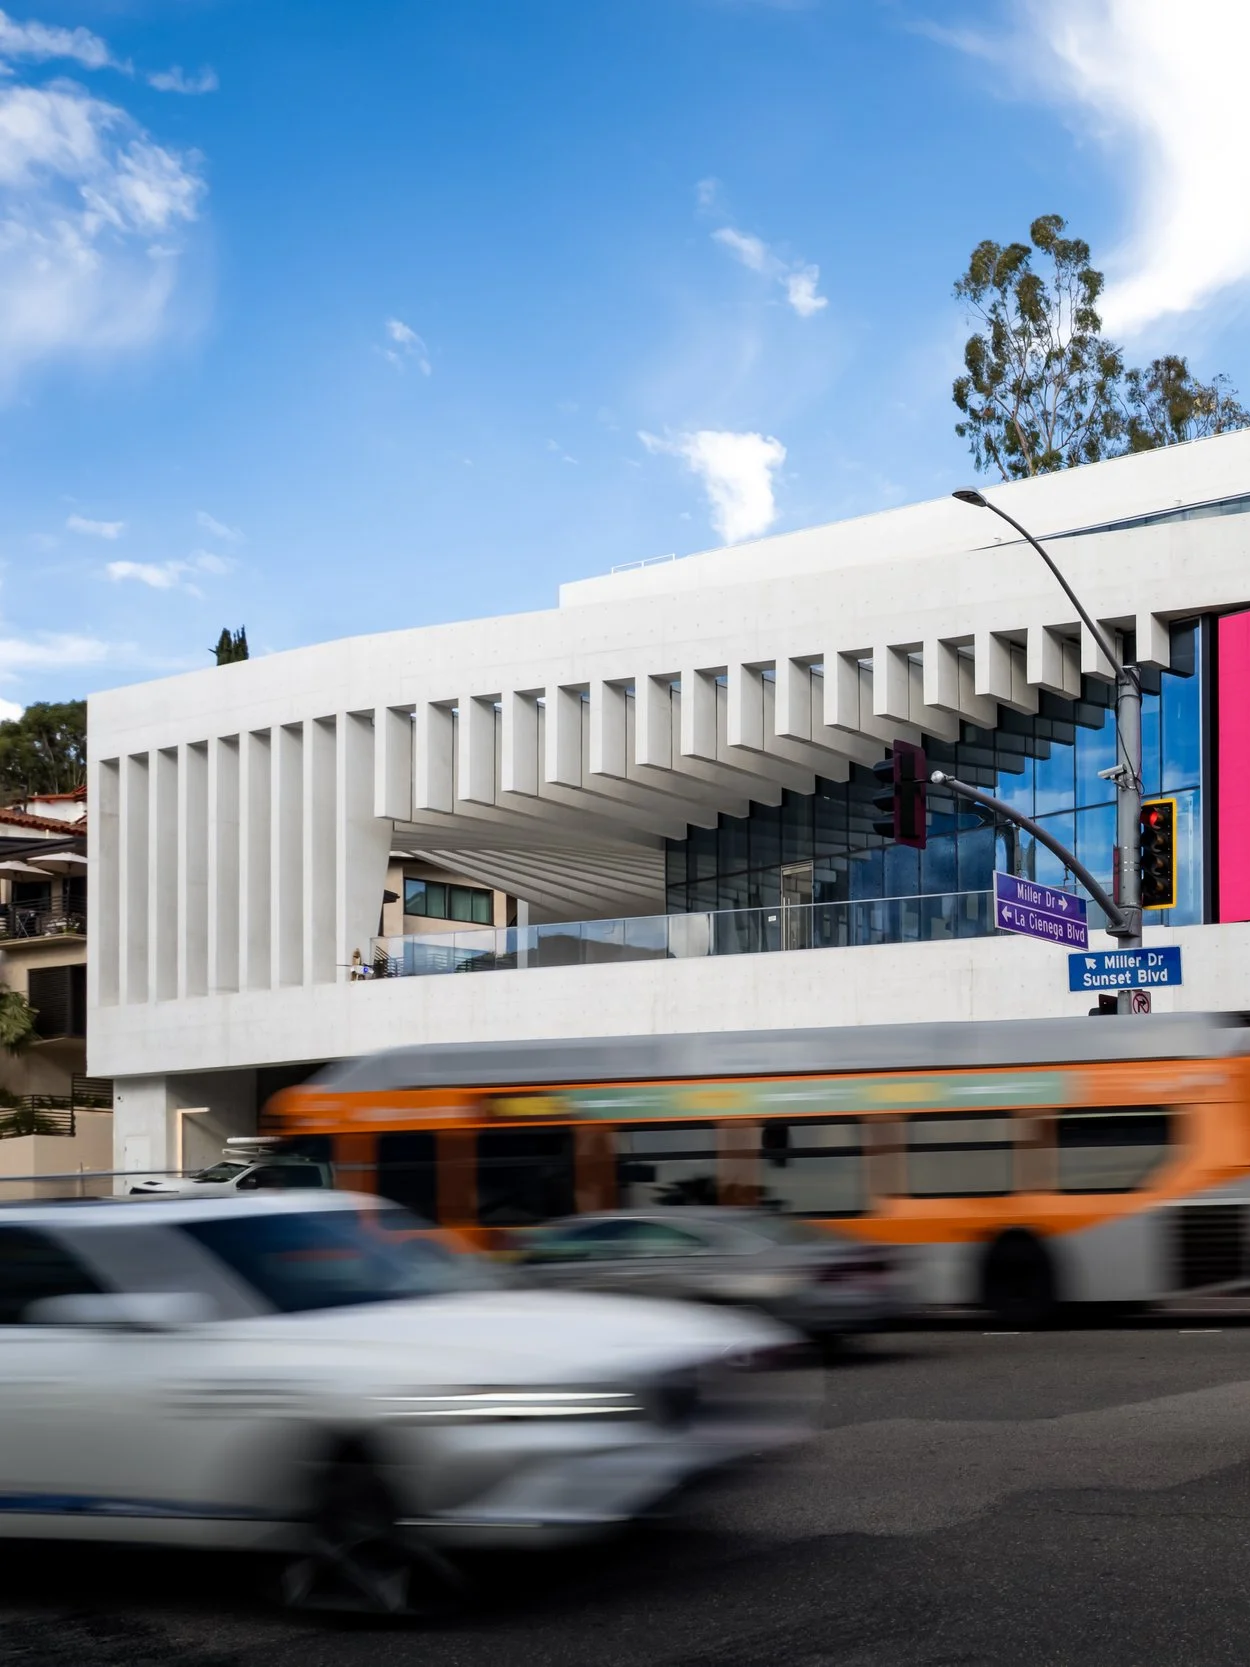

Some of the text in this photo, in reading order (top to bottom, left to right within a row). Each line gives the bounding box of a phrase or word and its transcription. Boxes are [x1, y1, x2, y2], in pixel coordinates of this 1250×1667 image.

[1017, 883, 1056, 908] Miller Dr
[1014, 909, 1085, 943] La Cienega Blvd
[1104, 952, 1164, 969] Miller Dr
[1083, 968, 1168, 987] Sunset Blvd
